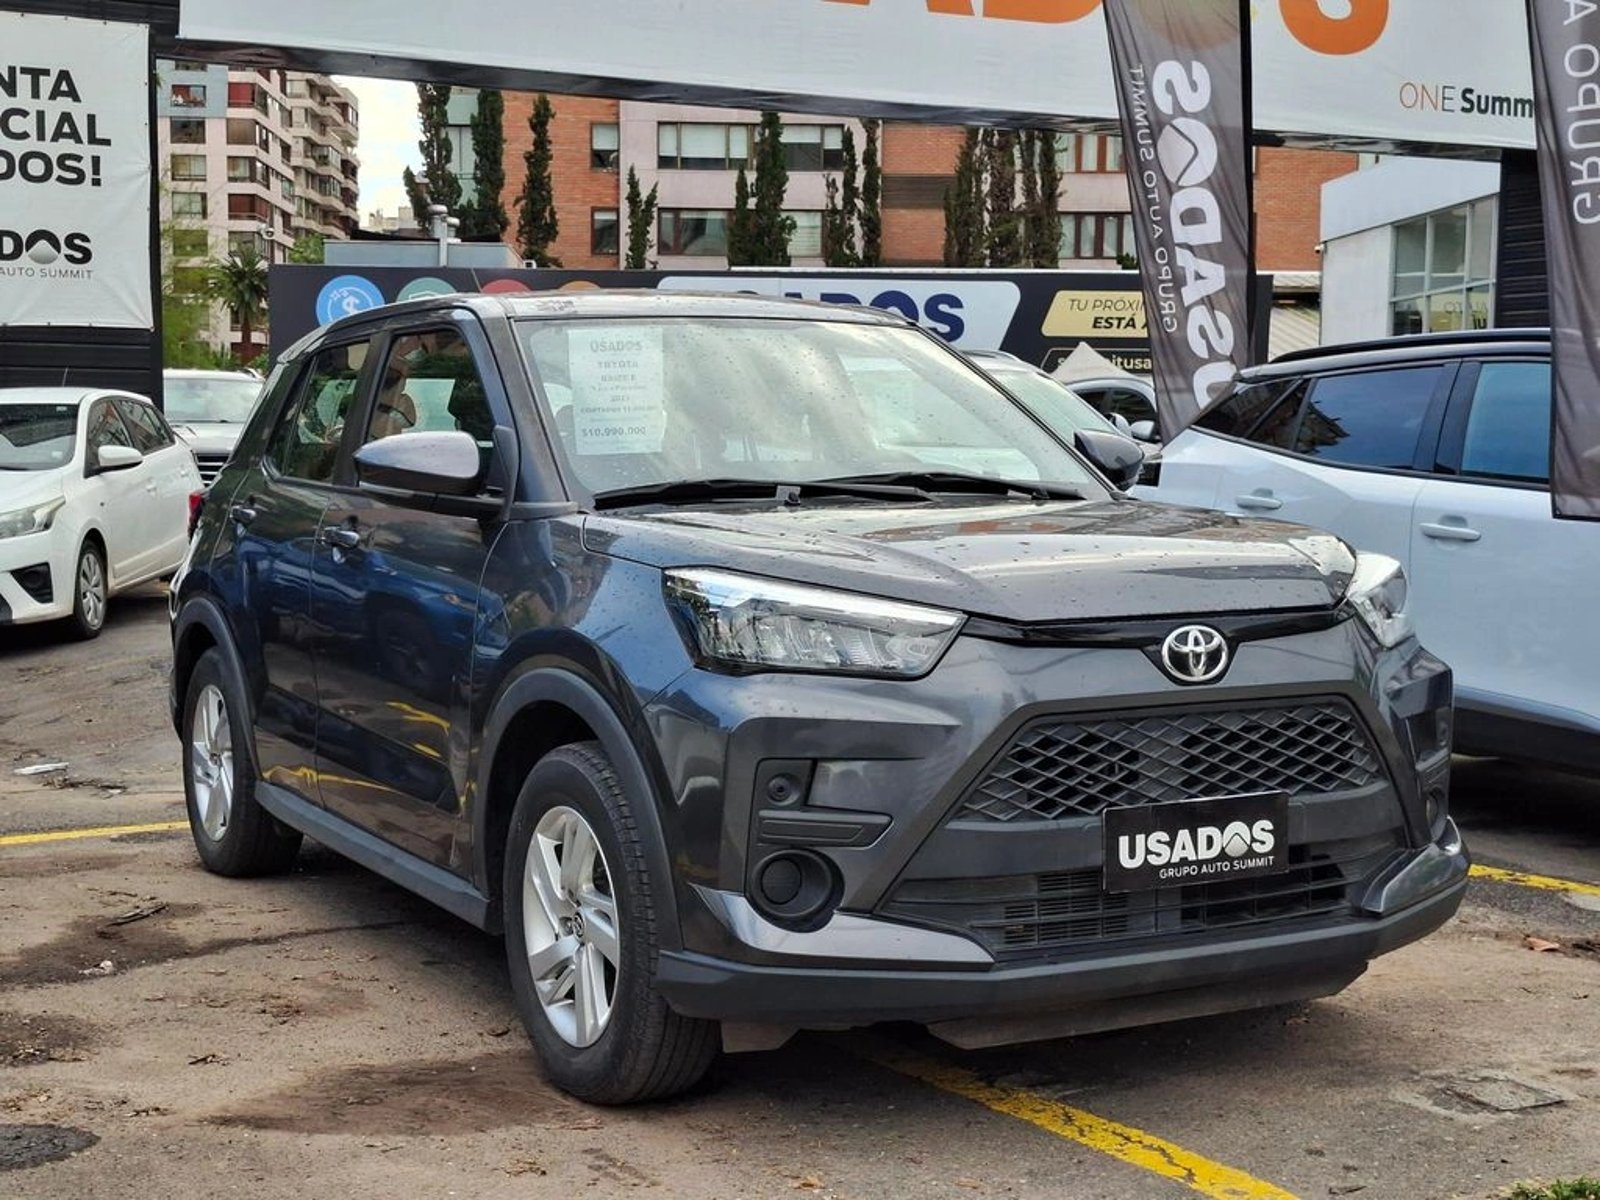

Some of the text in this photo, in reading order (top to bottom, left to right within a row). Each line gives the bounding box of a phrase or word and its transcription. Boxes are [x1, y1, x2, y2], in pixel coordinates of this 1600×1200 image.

[1400, 82, 1456, 113] ONE
[0, 107, 111, 147] CIAL
[40, 267, 93, 279] SUMMIT
[1069, 297, 1143, 312] TU PRÓXI
[1092, 314, 1137, 330] ESTÁ
[1119, 819, 1275, 869] USADOS
[1159, 856, 1275, 879] GRUPO AUTO SUMMIT
